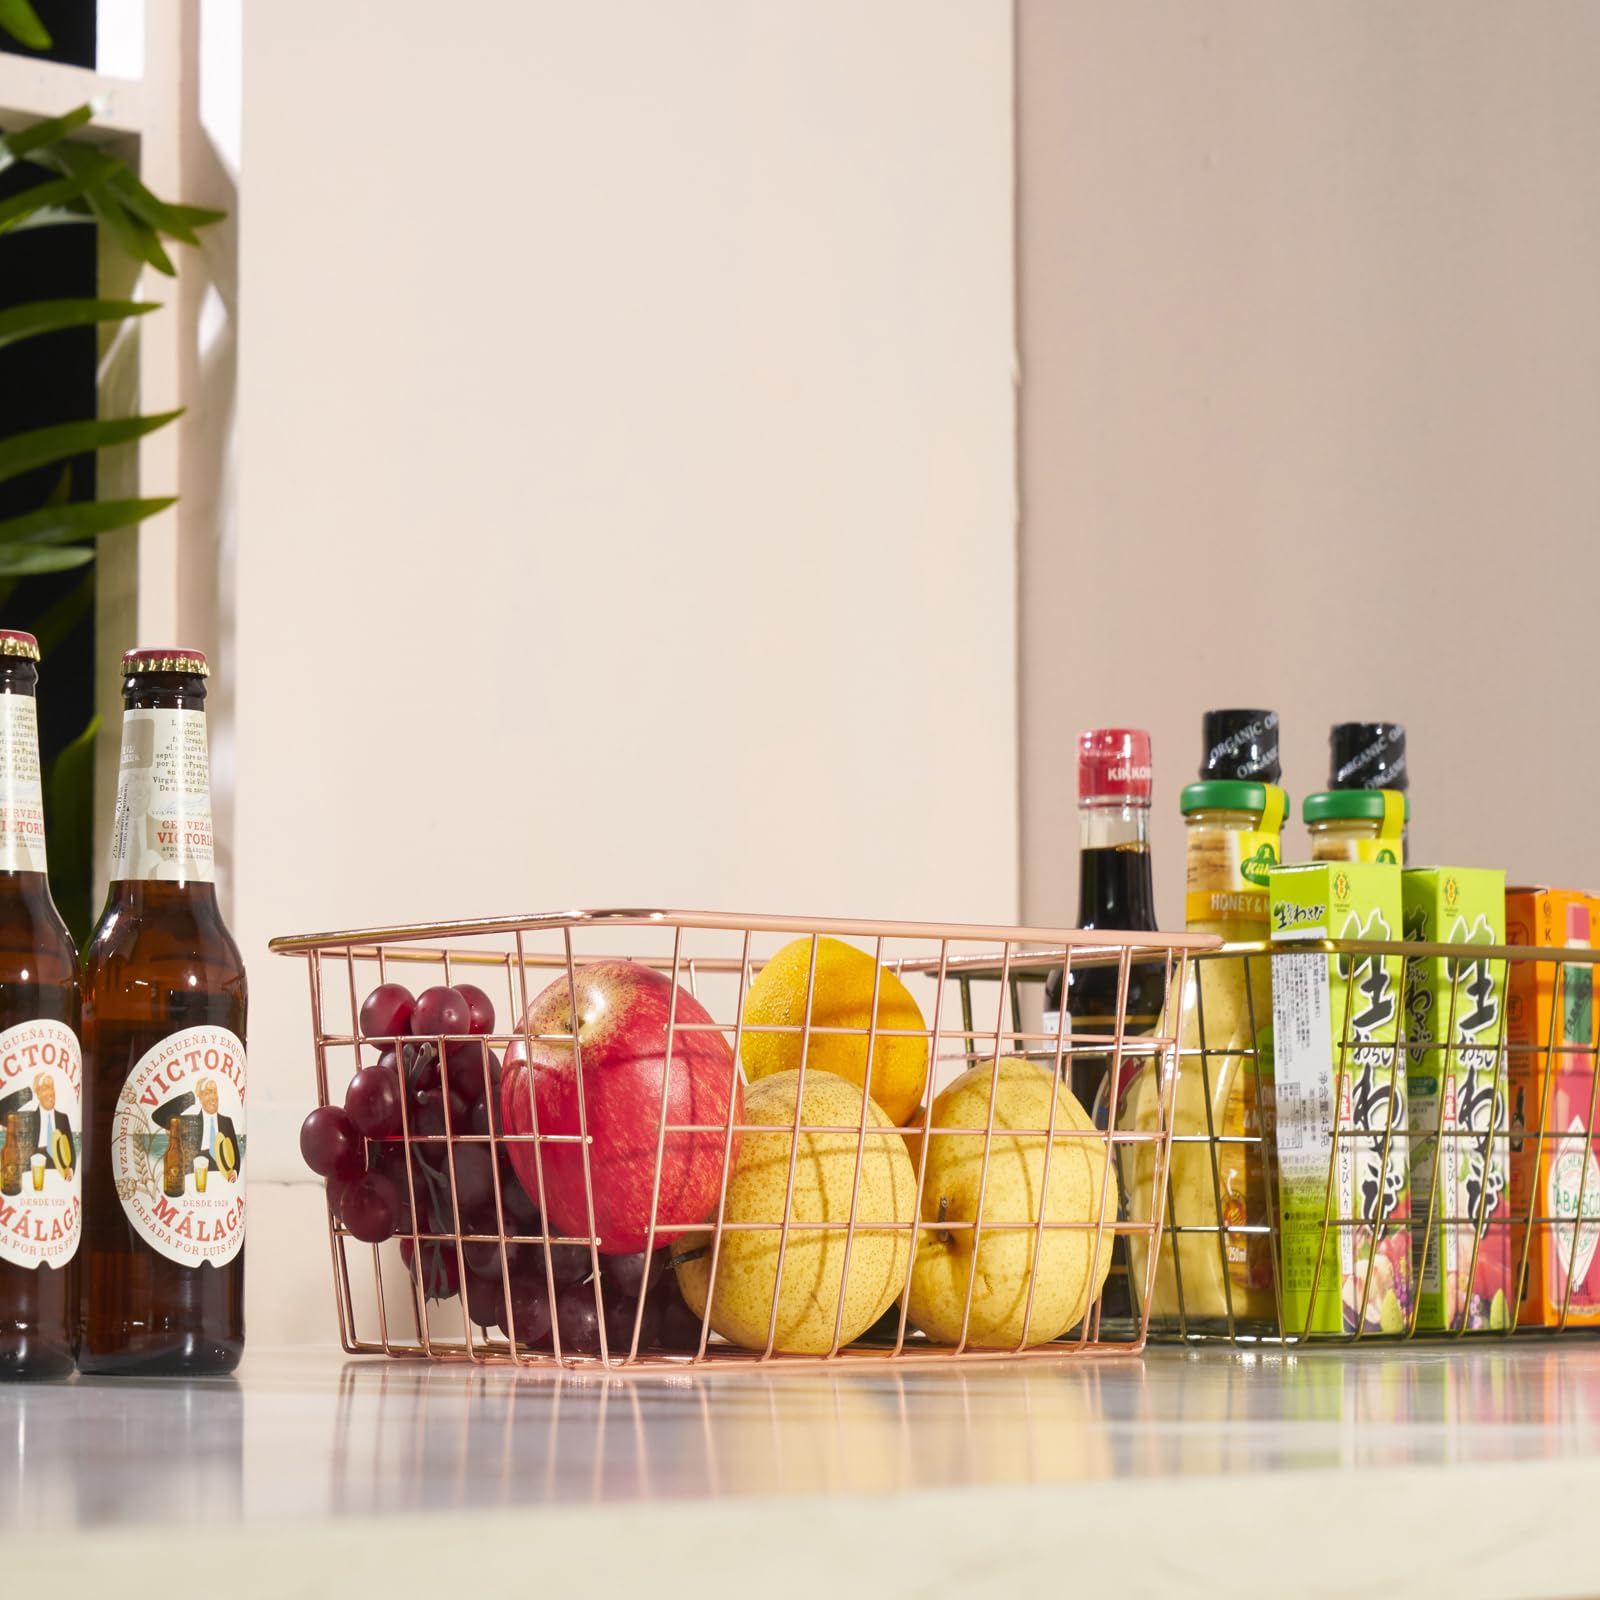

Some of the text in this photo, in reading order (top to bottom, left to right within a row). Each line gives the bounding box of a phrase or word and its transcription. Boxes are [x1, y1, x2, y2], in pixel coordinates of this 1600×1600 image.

[1210, 721, 1262, 760] ORGANIC
[1107, 766, 1152, 783] KIKKO
[1210, 893, 1251, 913] HONEY
[136, 1033, 207, 1087] MALAGUEÑA
[211, 1034, 217, 1044] Y
[140, 1048, 246, 1110] VICTORIA
[119, 1106, 132, 1175] CERVEZA
[20, 1198, 49, 1207] DESDE
[183, 1200, 212, 1208] DESDE
[132, 1198, 172, 1245] CREADA
[175, 1240, 199, 1256] POR
[203, 1244, 226, 1257] LUIS
[151, 1195, 245, 1242] MÁLAGA
[12, 1239, 63, 1257] POR LUIS
[1228, 1246, 1247, 1263] 250ml
